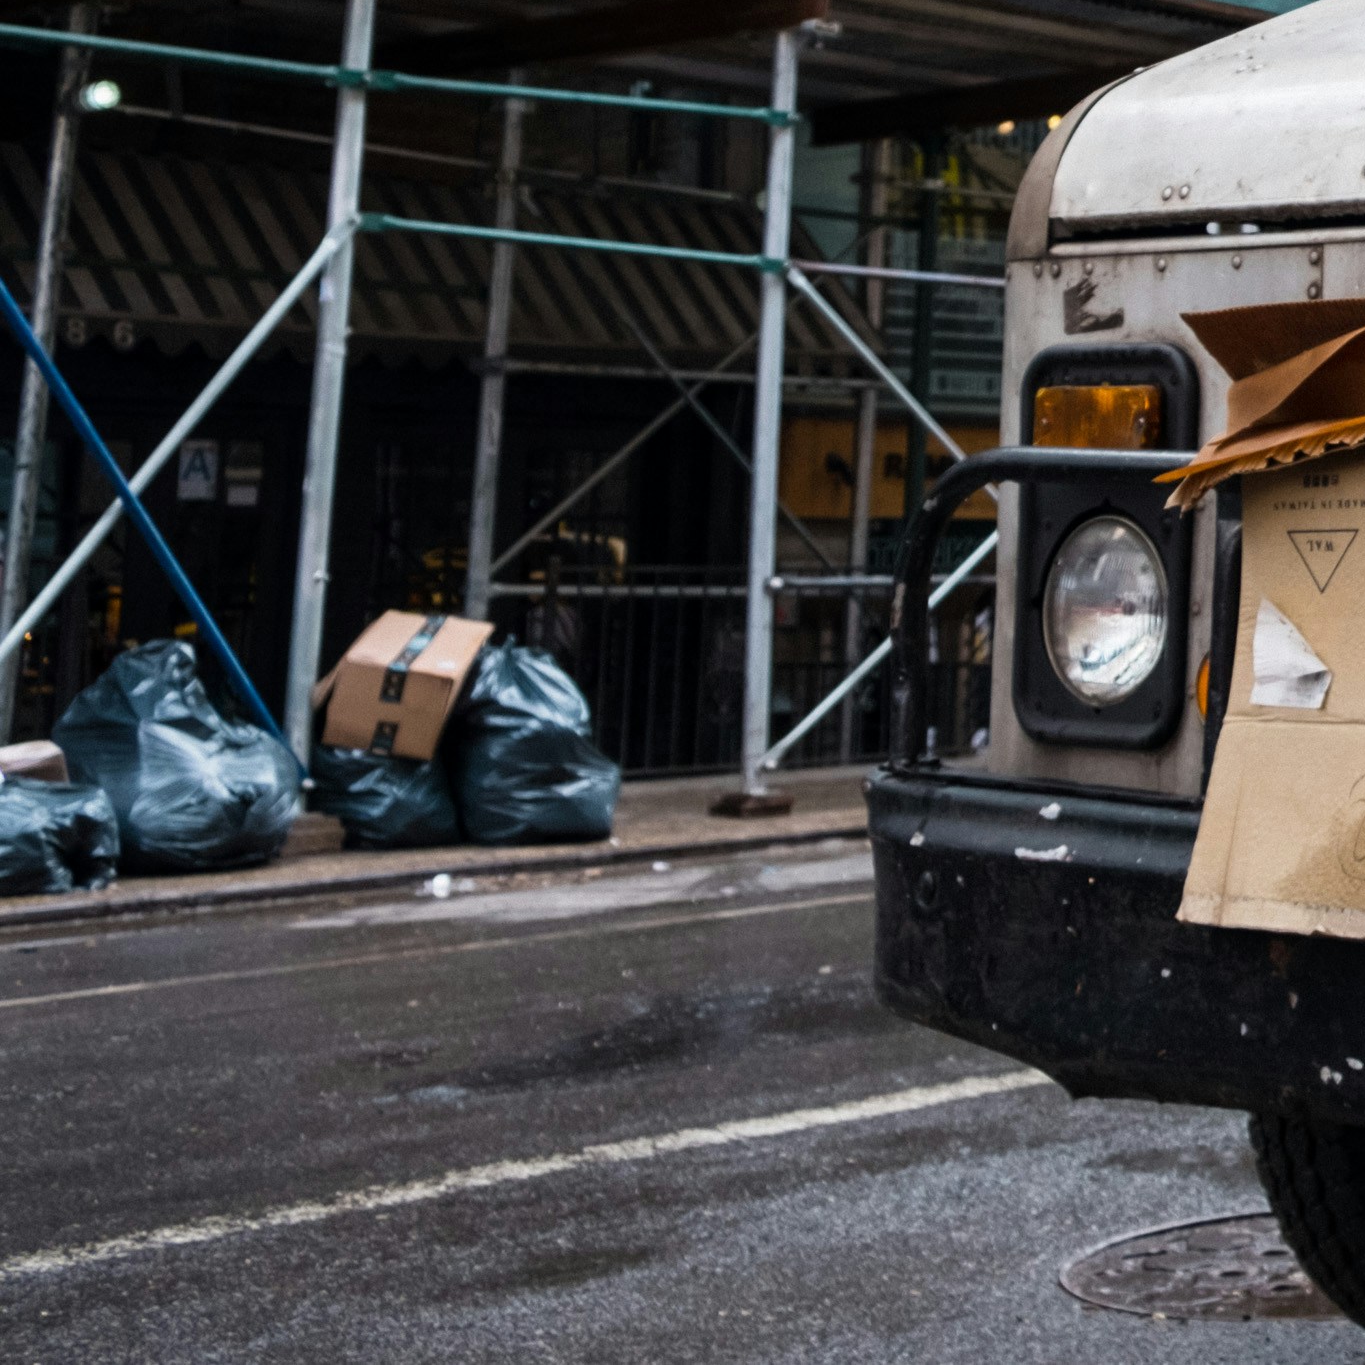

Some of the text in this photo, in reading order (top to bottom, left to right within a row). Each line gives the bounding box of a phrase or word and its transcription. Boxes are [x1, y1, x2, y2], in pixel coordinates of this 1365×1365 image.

[181, 447, 211, 482] A
[1271, 500, 1316, 511] TAIWAN
[1319, 500, 1333, 510] IN
[1306, 539, 1335, 552] WAL
